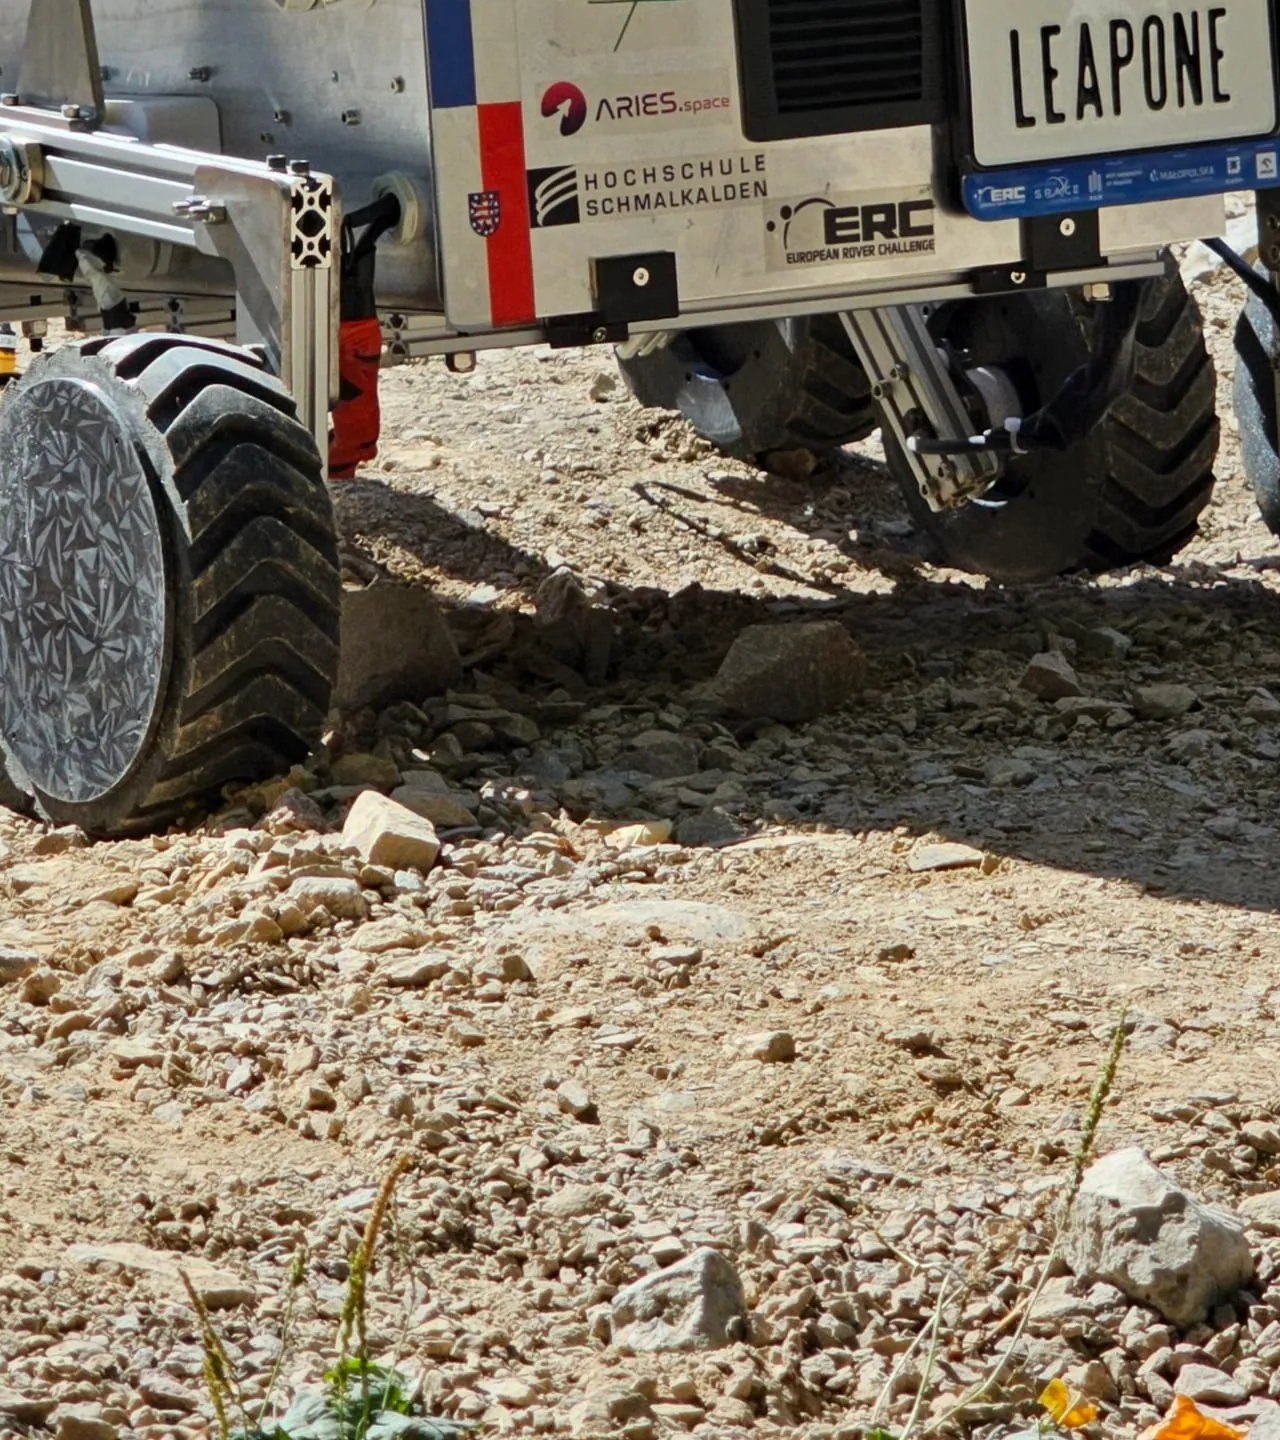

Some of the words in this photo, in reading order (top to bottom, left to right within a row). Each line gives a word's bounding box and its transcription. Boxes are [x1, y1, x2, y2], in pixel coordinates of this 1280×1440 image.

[1009, 7, 1232, 129] LEAPONE
[584, 154, 766, 191] HOCHSCHULE
[586, 179, 768, 217] SCHMALKALDEN
[990, 186, 1026, 202] ERC
[824, 198, 935, 245] ERC
[786, 248, 840, 265] EUROPEAN
[842, 244, 876, 258] ROVER
[878, 238, 936, 256] CHALLENGE
